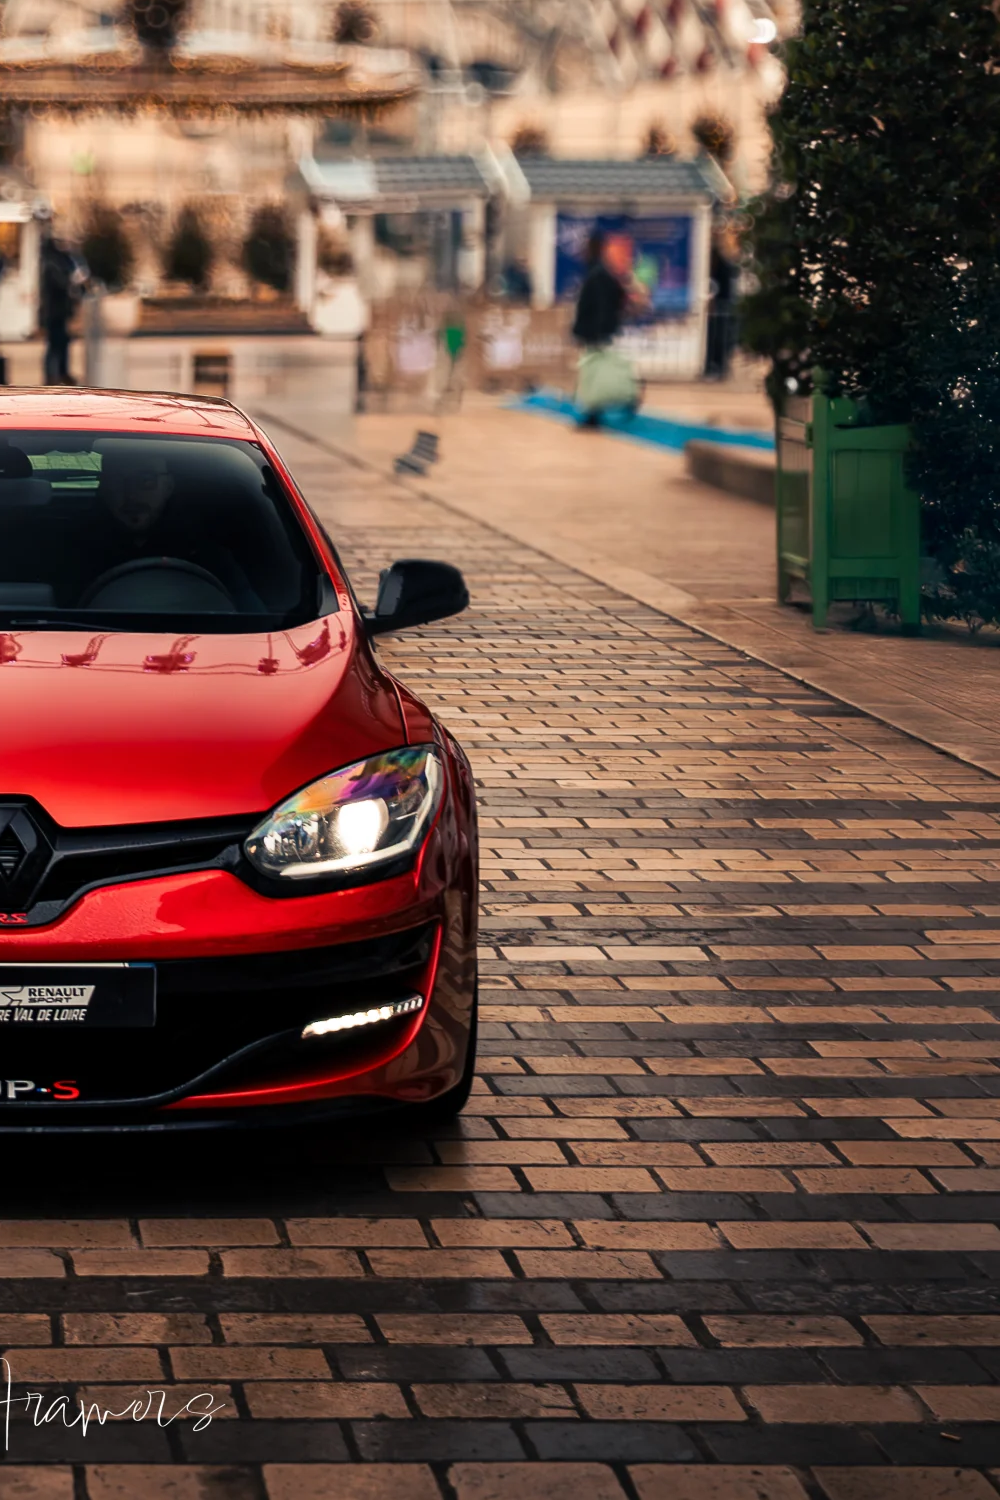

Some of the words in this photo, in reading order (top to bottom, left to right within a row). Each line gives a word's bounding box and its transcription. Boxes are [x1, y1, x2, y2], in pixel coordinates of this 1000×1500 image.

[28, 987, 86, 997] RENAULT
[14, 1008, 34, 1021] VAL
[37, 1009, 52, 1021] DE
[53, 1009, 87, 1021] LOIRE
